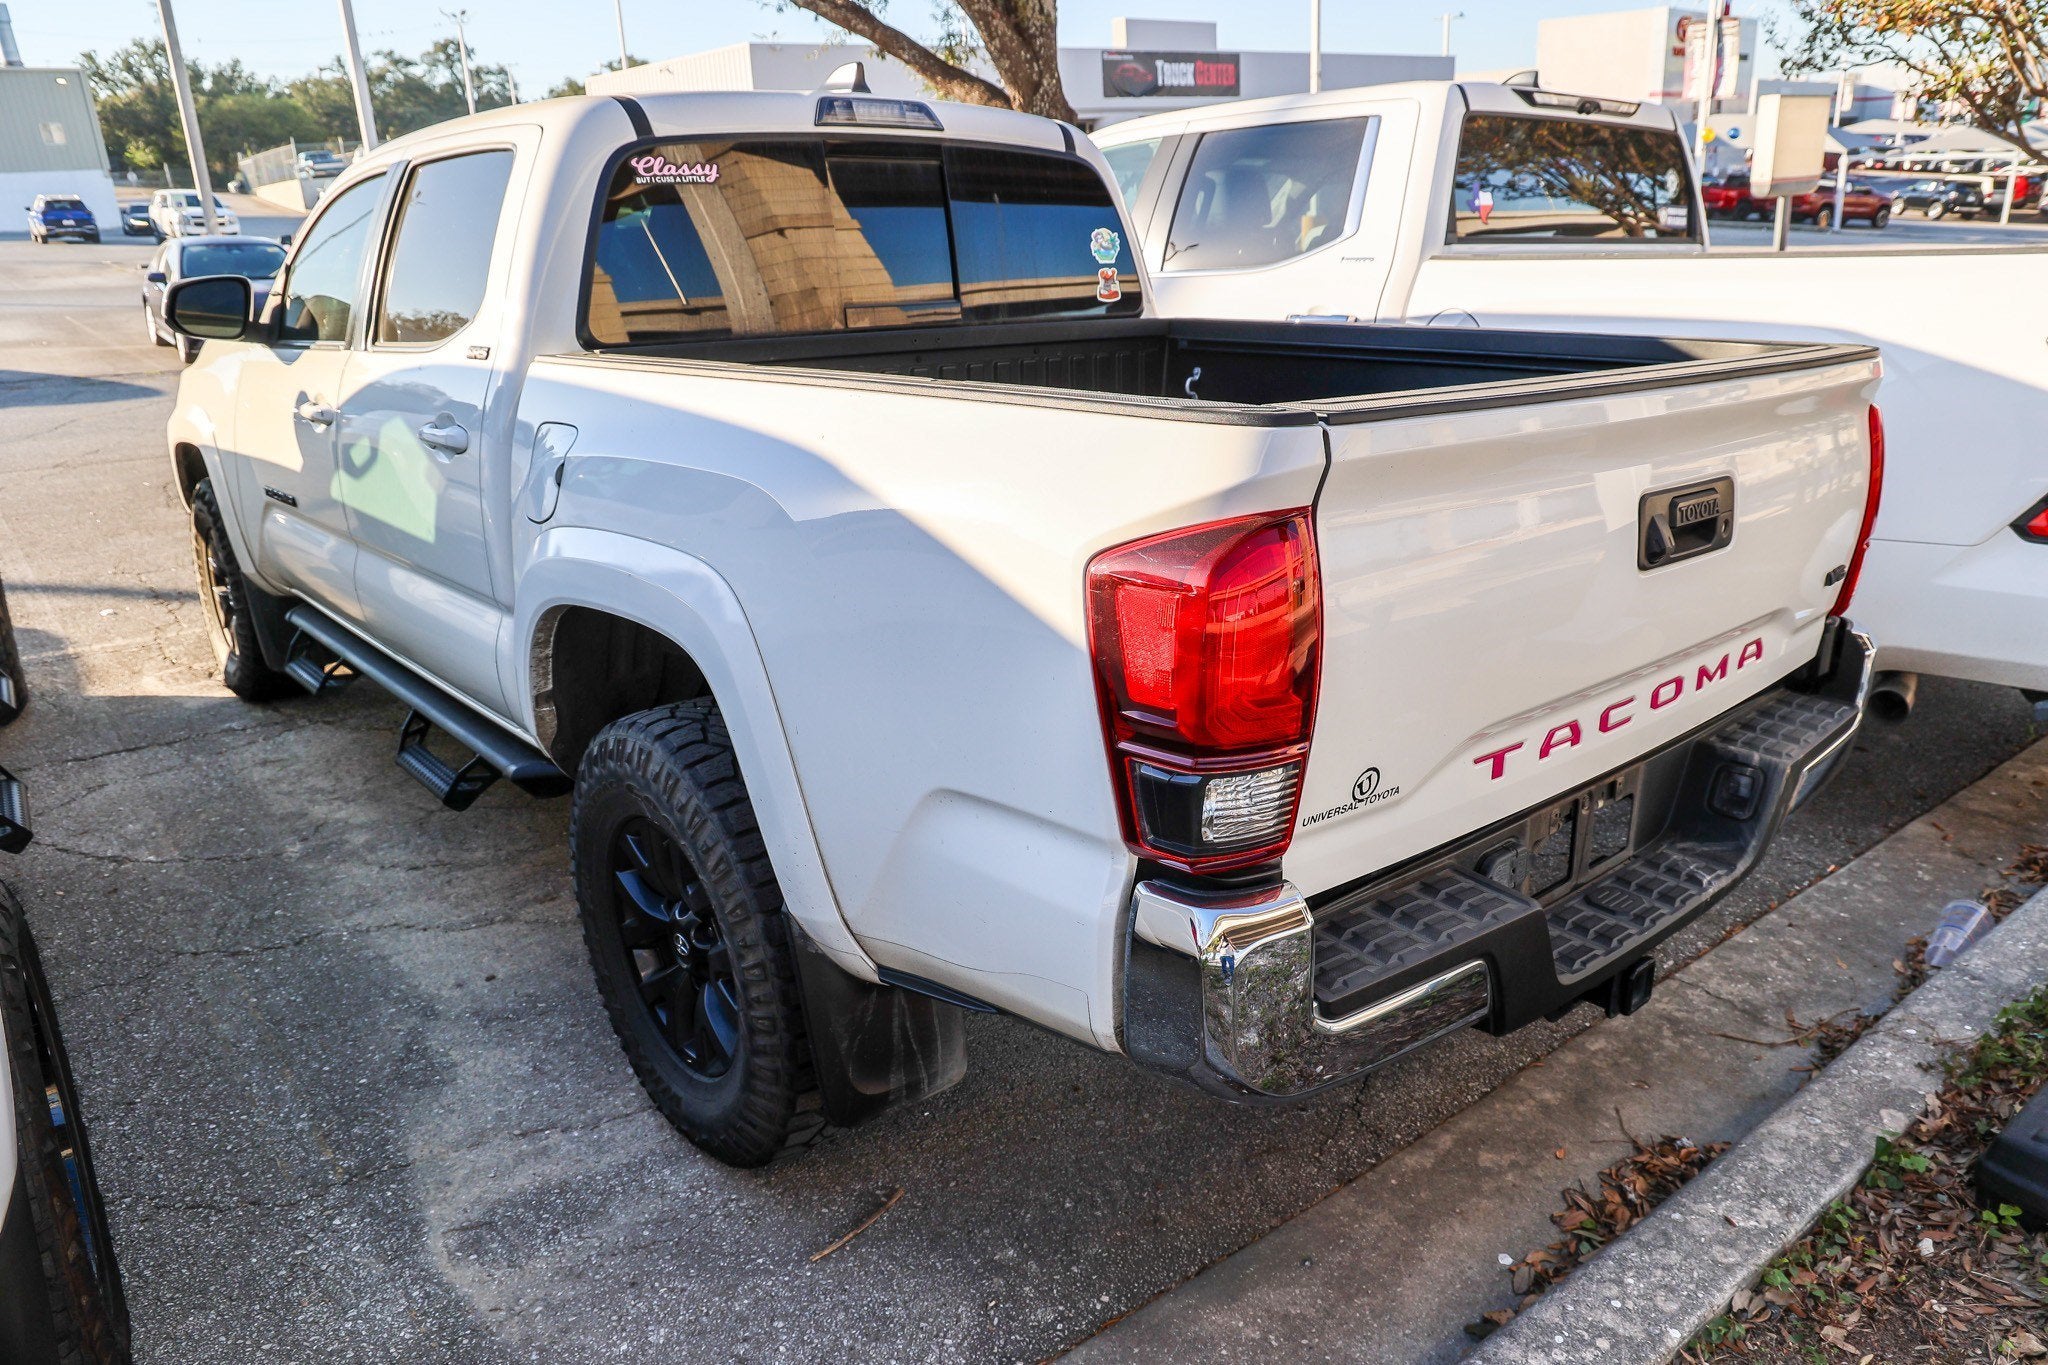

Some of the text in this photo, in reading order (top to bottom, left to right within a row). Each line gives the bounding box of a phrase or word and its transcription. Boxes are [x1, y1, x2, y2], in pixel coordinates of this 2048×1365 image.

[1155, 59, 1195, 87] TRUCK
[630, 156, 720, 183] Classy
[635, 176, 651, 184] BUT
[656, 175, 675, 183] CUSS
[683, 175, 706, 183] LITTLE
[1679, 498, 1720, 524] TOYOTA
[1473, 638, 1763, 781] TACOMA
[1302, 785, 1400, 827] UNIVERSAL TOYOTA
